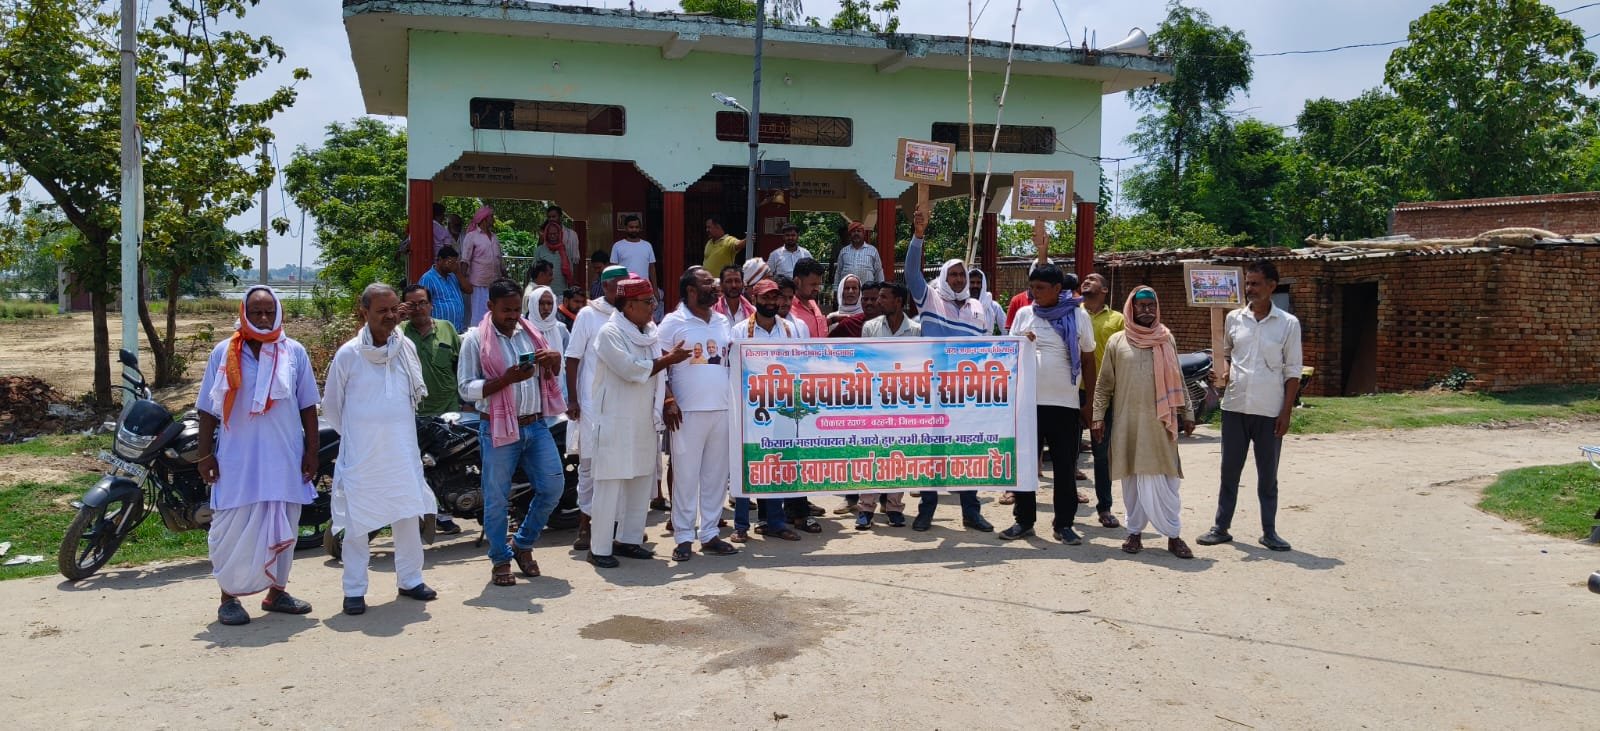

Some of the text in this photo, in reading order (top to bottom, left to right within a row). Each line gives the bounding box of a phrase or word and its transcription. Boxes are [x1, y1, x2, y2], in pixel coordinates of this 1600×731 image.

[748, 359, 1011, 422] भूमि बचाओ संघर्ष समिति
[821, 418, 845, 427] विकास
[761, 432, 999, 448] किसान महापंचायत में आये हुए सभी किसान भाइयों का
[749, 452, 797, 485] हार्दिक
[800, 459, 849, 483] स्वागत
[850, 451, 875, 483] एवं
[876, 450, 948, 480] अभिनन्दन
[950, 455, 989, 479] करता
